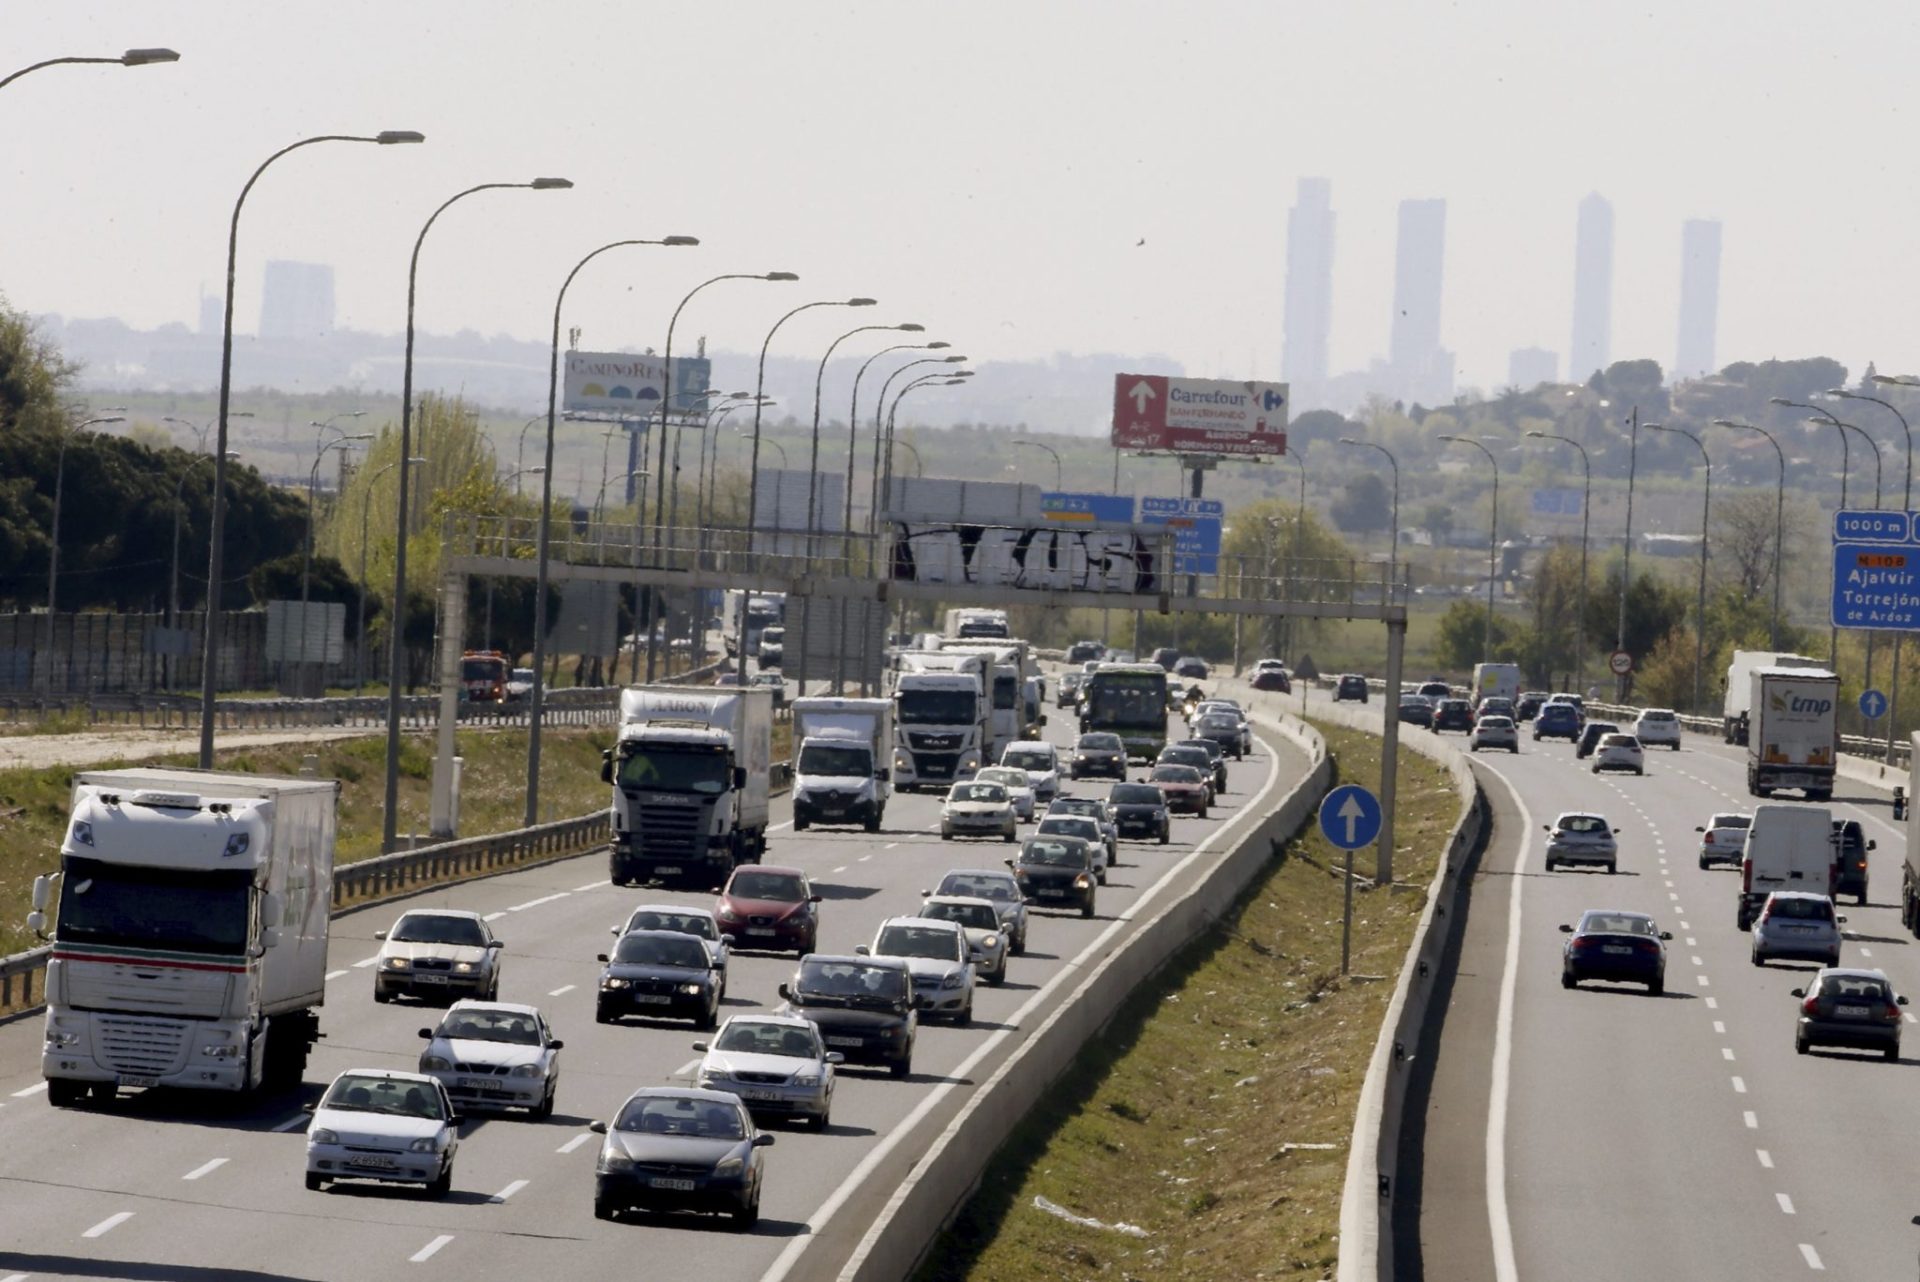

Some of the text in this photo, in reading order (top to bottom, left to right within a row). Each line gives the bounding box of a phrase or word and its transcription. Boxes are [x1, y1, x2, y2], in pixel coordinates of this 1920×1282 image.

[1170, 387, 1248, 406] Carrefour
[1844, 520, 1900, 532] 1000 m
[1848, 569, 1914, 588] Ajalvir
[1843, 590, 1920, 610] Torrejón
[1847, 610, 1912, 622] de Ardoz
[1791, 696, 1831, 716] tmp
